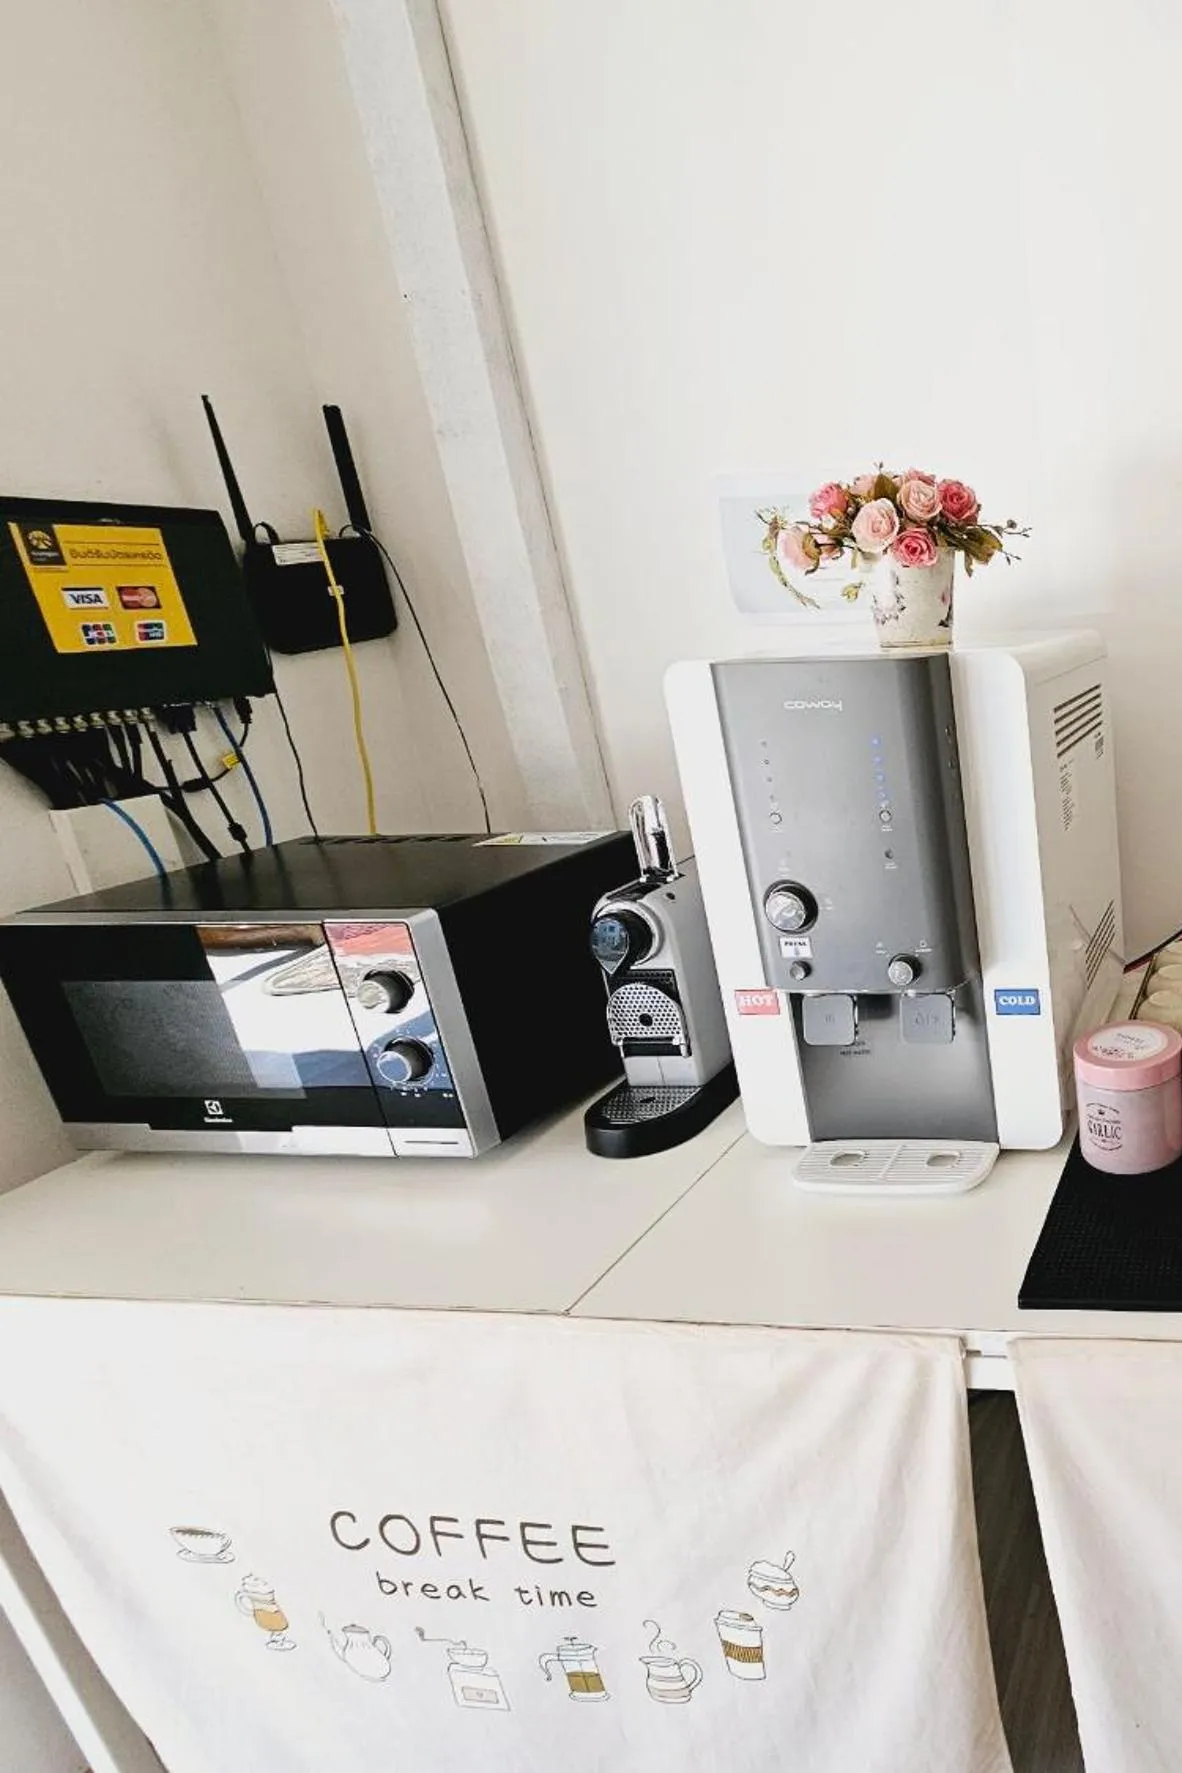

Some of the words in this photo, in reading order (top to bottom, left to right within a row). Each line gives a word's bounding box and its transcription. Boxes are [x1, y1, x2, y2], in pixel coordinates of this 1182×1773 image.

[68, 593, 104, 605] VISA
[739, 995, 773, 1008] HOT
[999, 995, 1036, 1006] COLD
[330, 1510, 616, 1566] COFFEE
[376, 1571, 490, 1601] break
[514, 1584, 598, 1607] time
